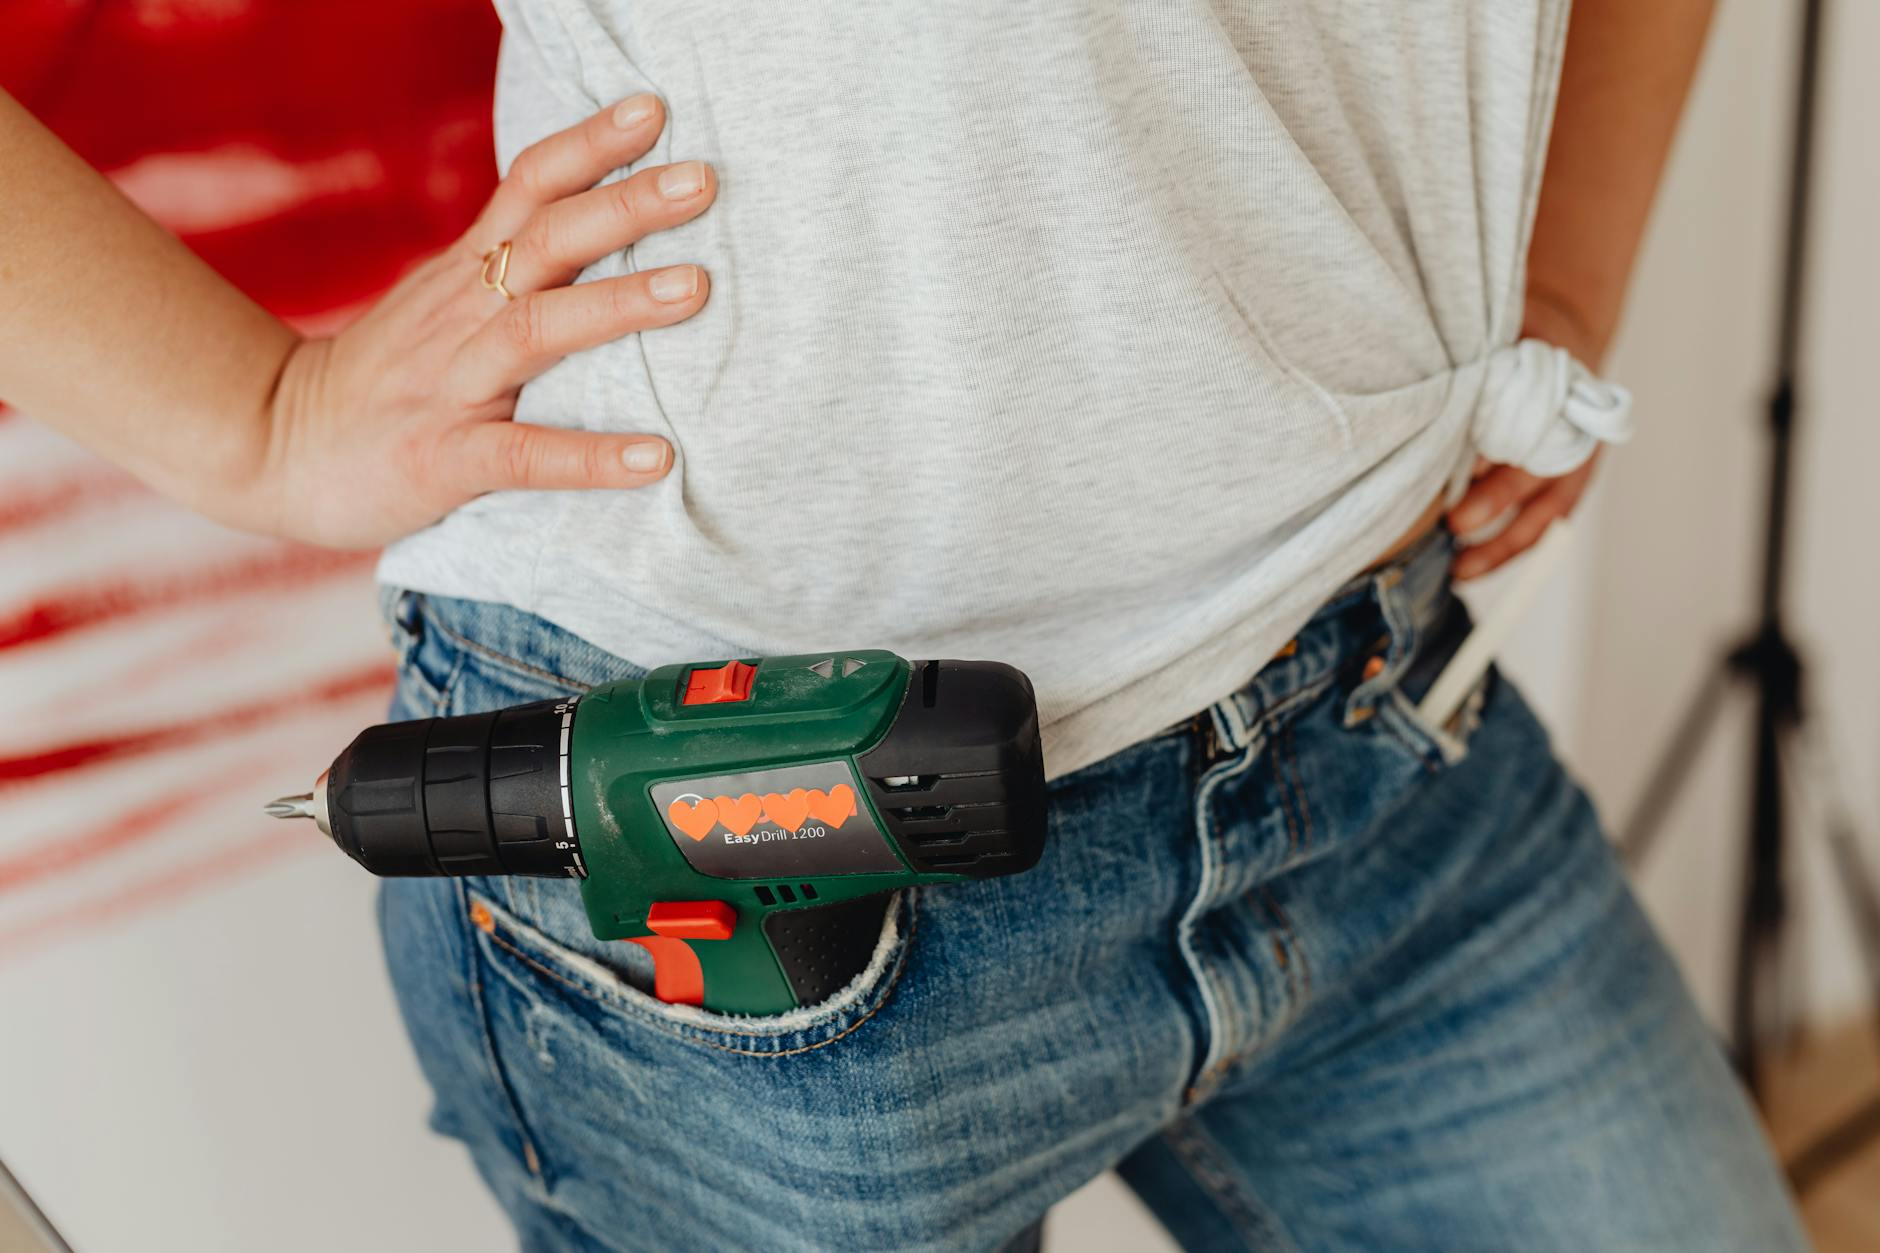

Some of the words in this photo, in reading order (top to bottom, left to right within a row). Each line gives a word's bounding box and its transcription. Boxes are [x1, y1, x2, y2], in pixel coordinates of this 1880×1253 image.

[553, 703, 568, 714] 10
[791, 826, 826, 841] 1200
[555, 841, 569, 850] 5
